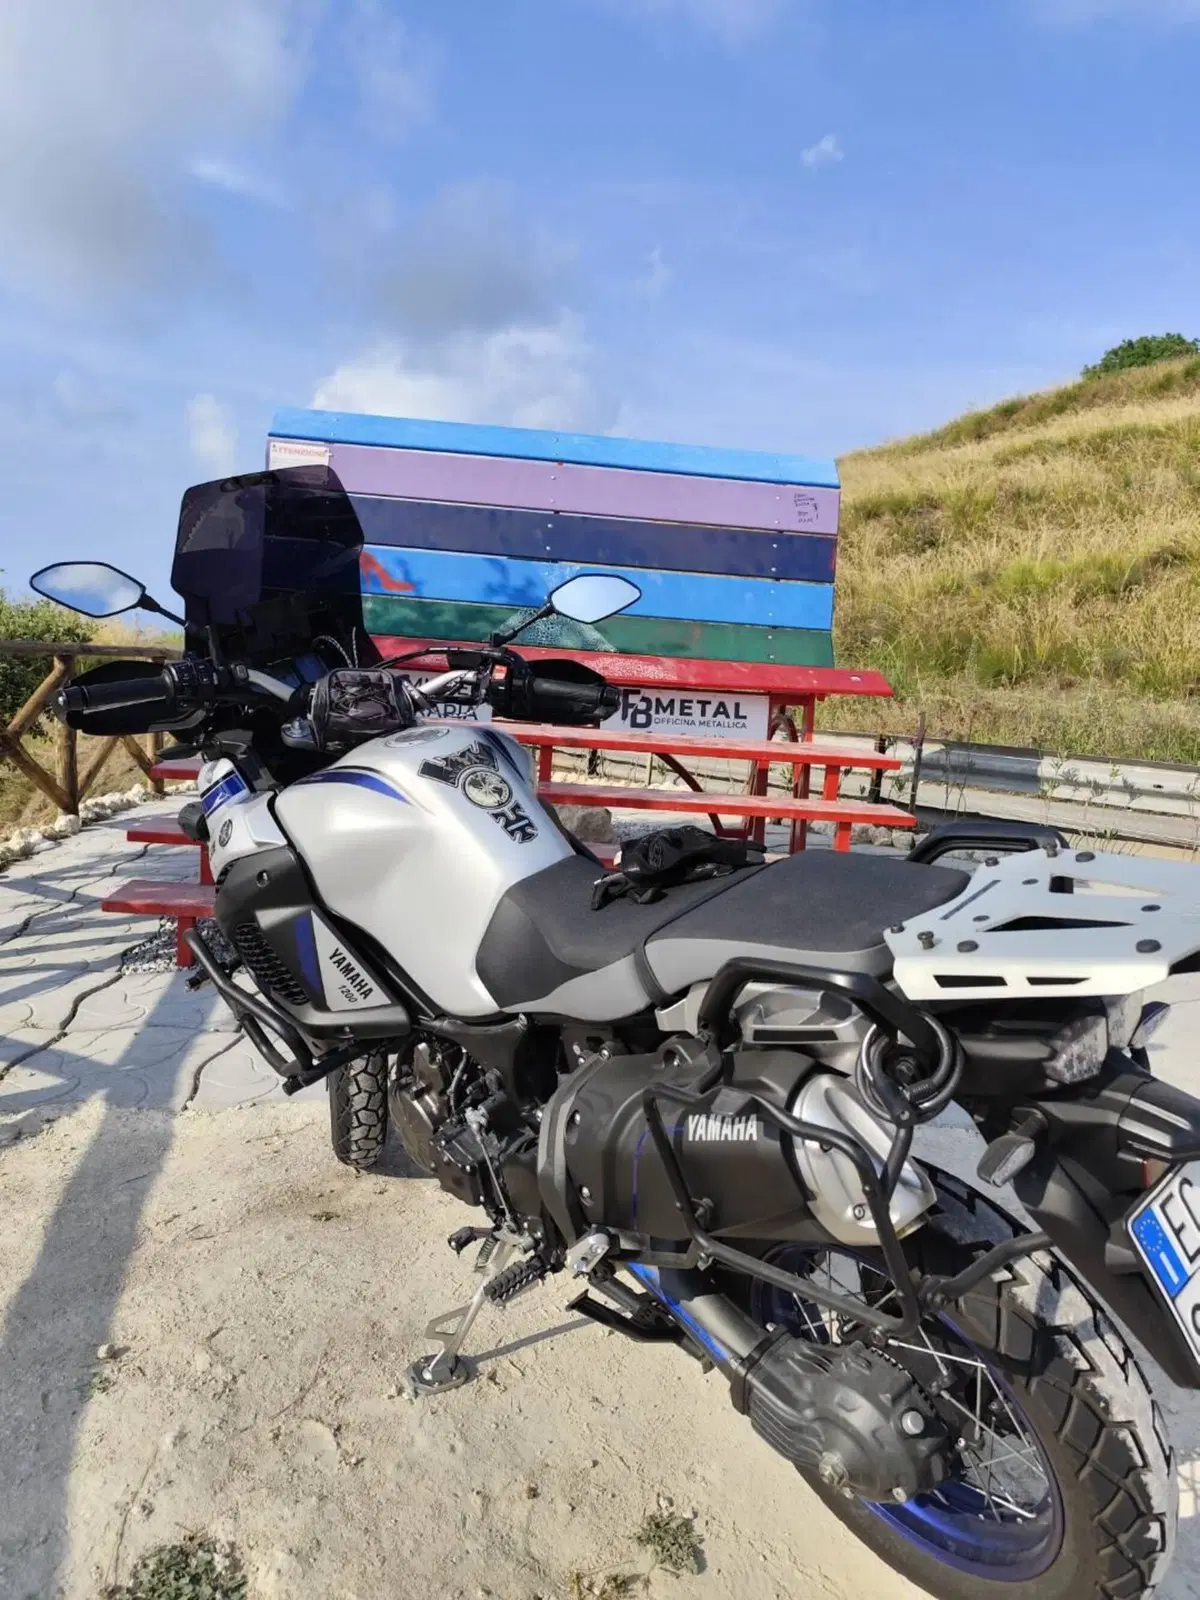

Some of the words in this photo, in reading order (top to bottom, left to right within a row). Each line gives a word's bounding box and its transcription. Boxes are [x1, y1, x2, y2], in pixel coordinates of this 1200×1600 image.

[654, 697, 747, 720] METAL
[653, 716, 696, 727] OFFICINA
[698, 720, 748, 730] METALLICA
[328, 947, 374, 1001] YAMAHA
[337, 984, 358, 1003] 1200
[688, 1113, 758, 1142] YAMAHA
